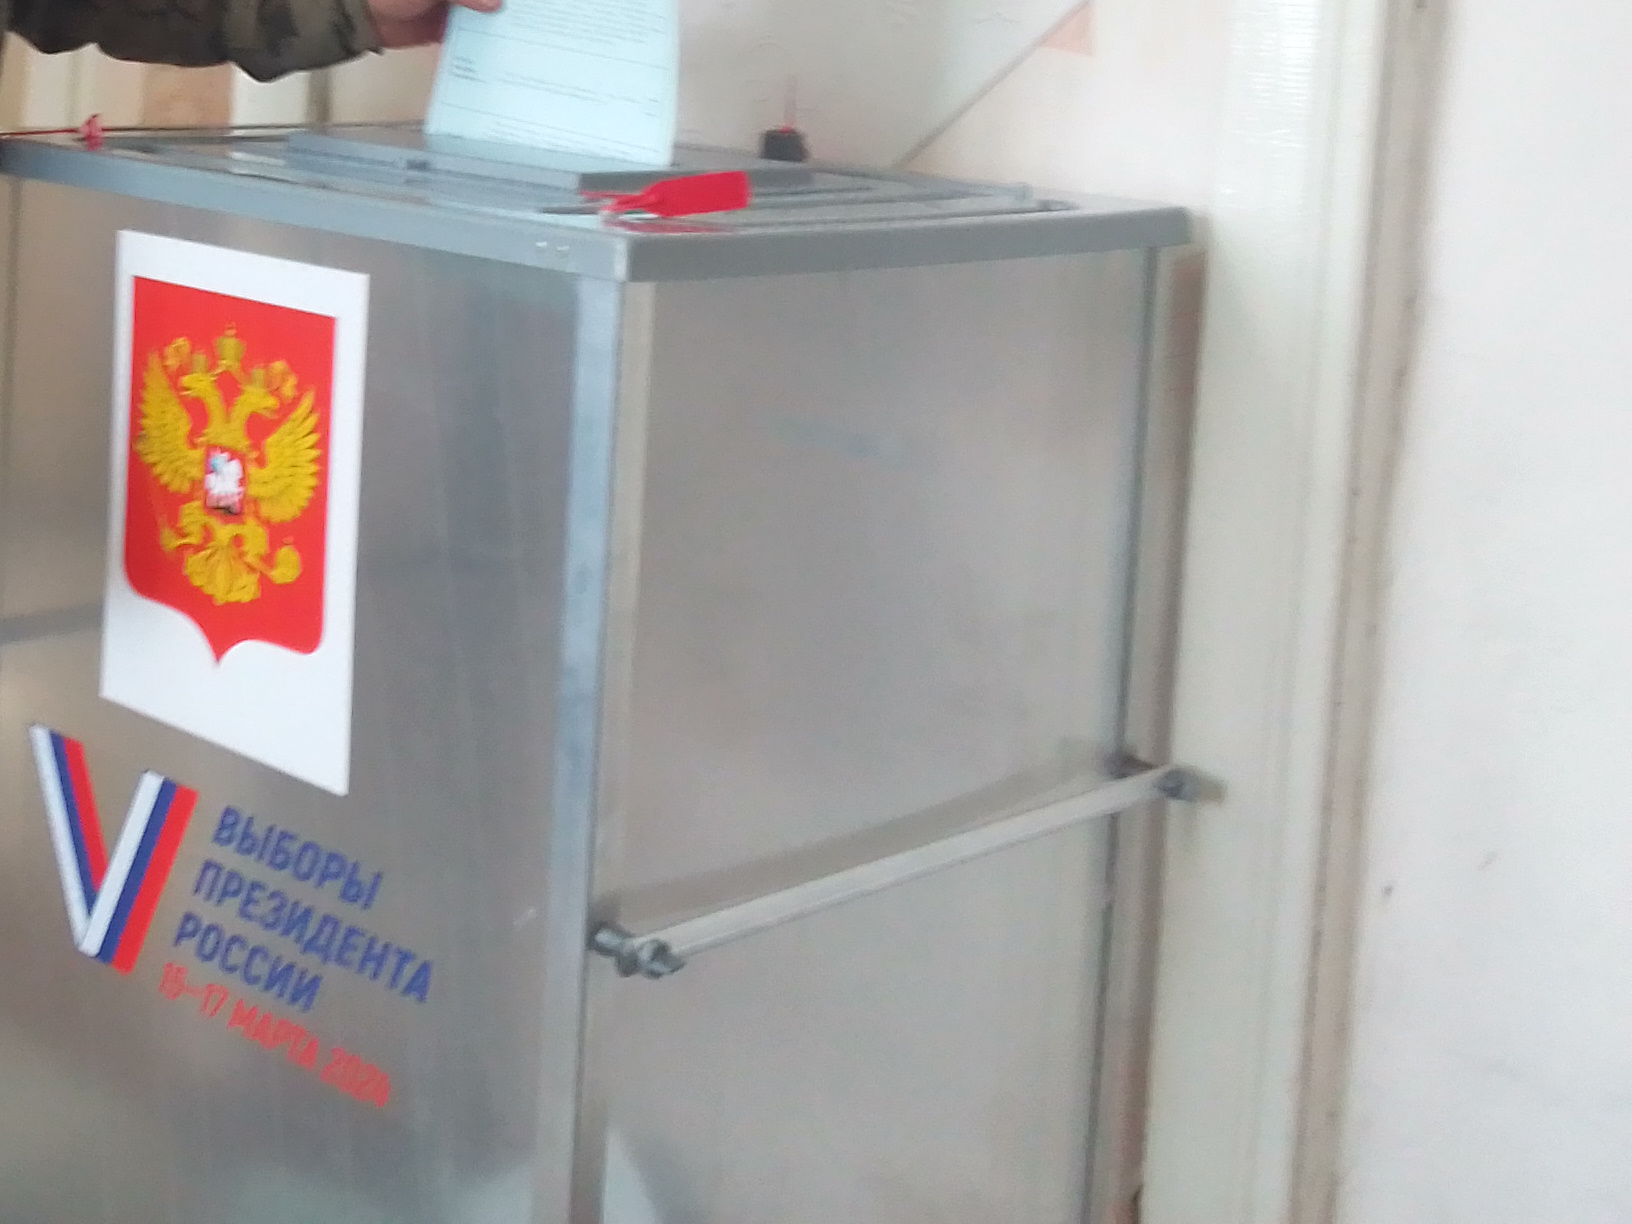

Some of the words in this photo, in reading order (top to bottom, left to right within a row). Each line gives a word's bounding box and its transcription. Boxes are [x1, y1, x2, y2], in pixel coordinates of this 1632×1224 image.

[211, 805, 384, 910] ВЫБОРЫ
[172, 910, 325, 1013] РОССИИ
[192, 858, 435, 1004] ПРЕЗИДЕНТА
